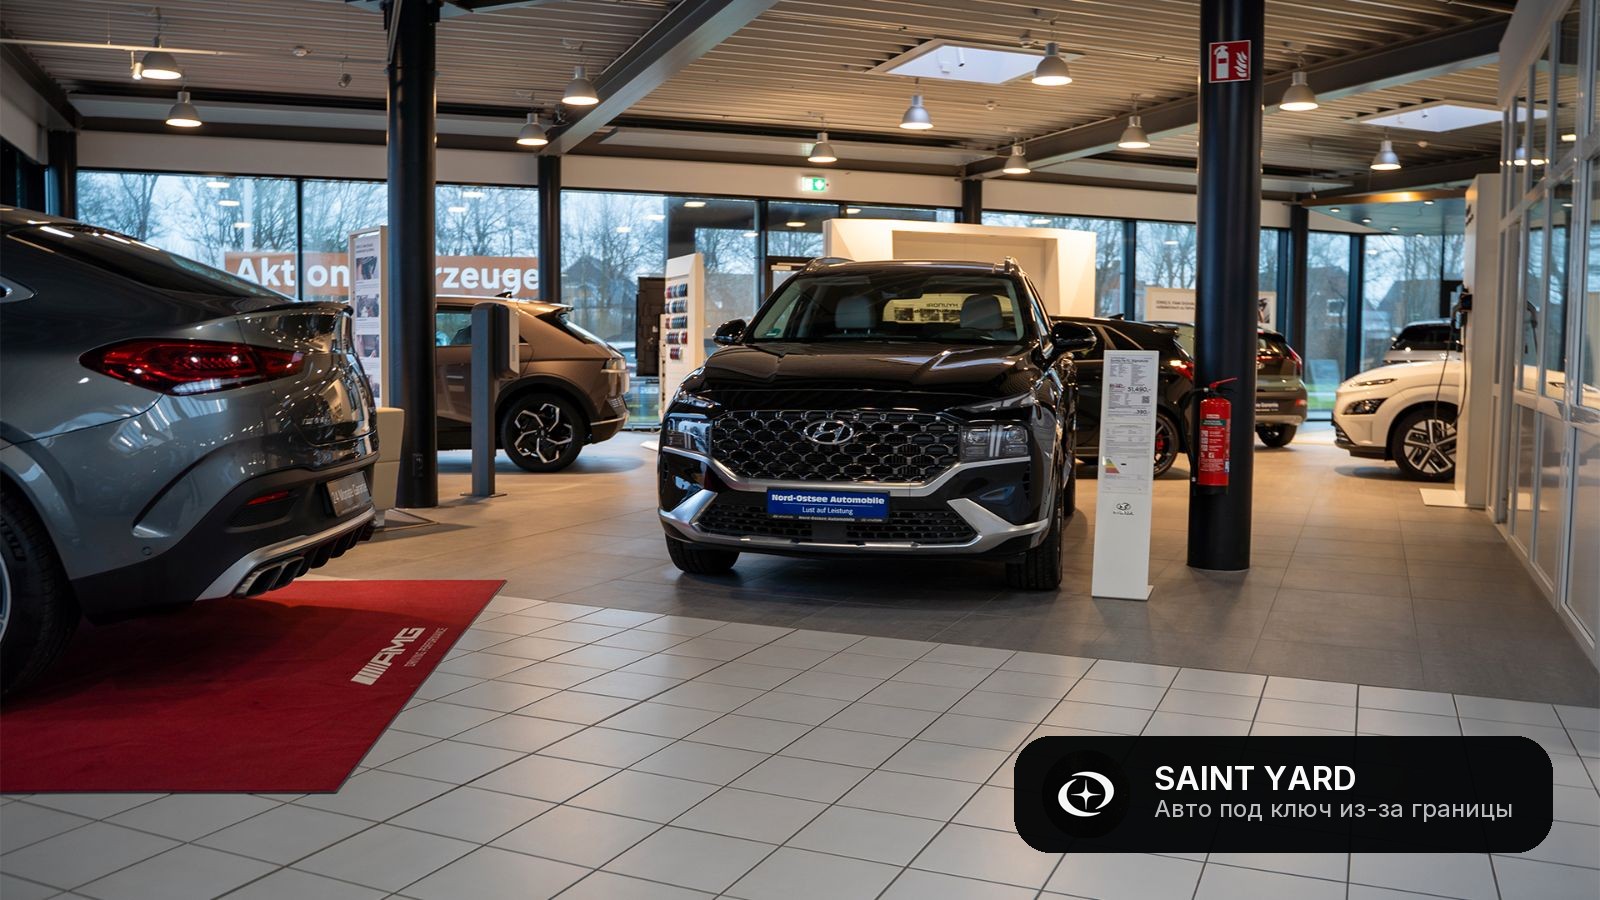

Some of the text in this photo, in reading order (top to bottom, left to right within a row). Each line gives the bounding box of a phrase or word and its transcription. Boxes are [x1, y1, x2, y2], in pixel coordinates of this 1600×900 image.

[771, 494, 885, 505] Nord-Ostsee Automobile
[827, 507, 853, 515] Leistung
[366, 627, 426, 668] AMG
